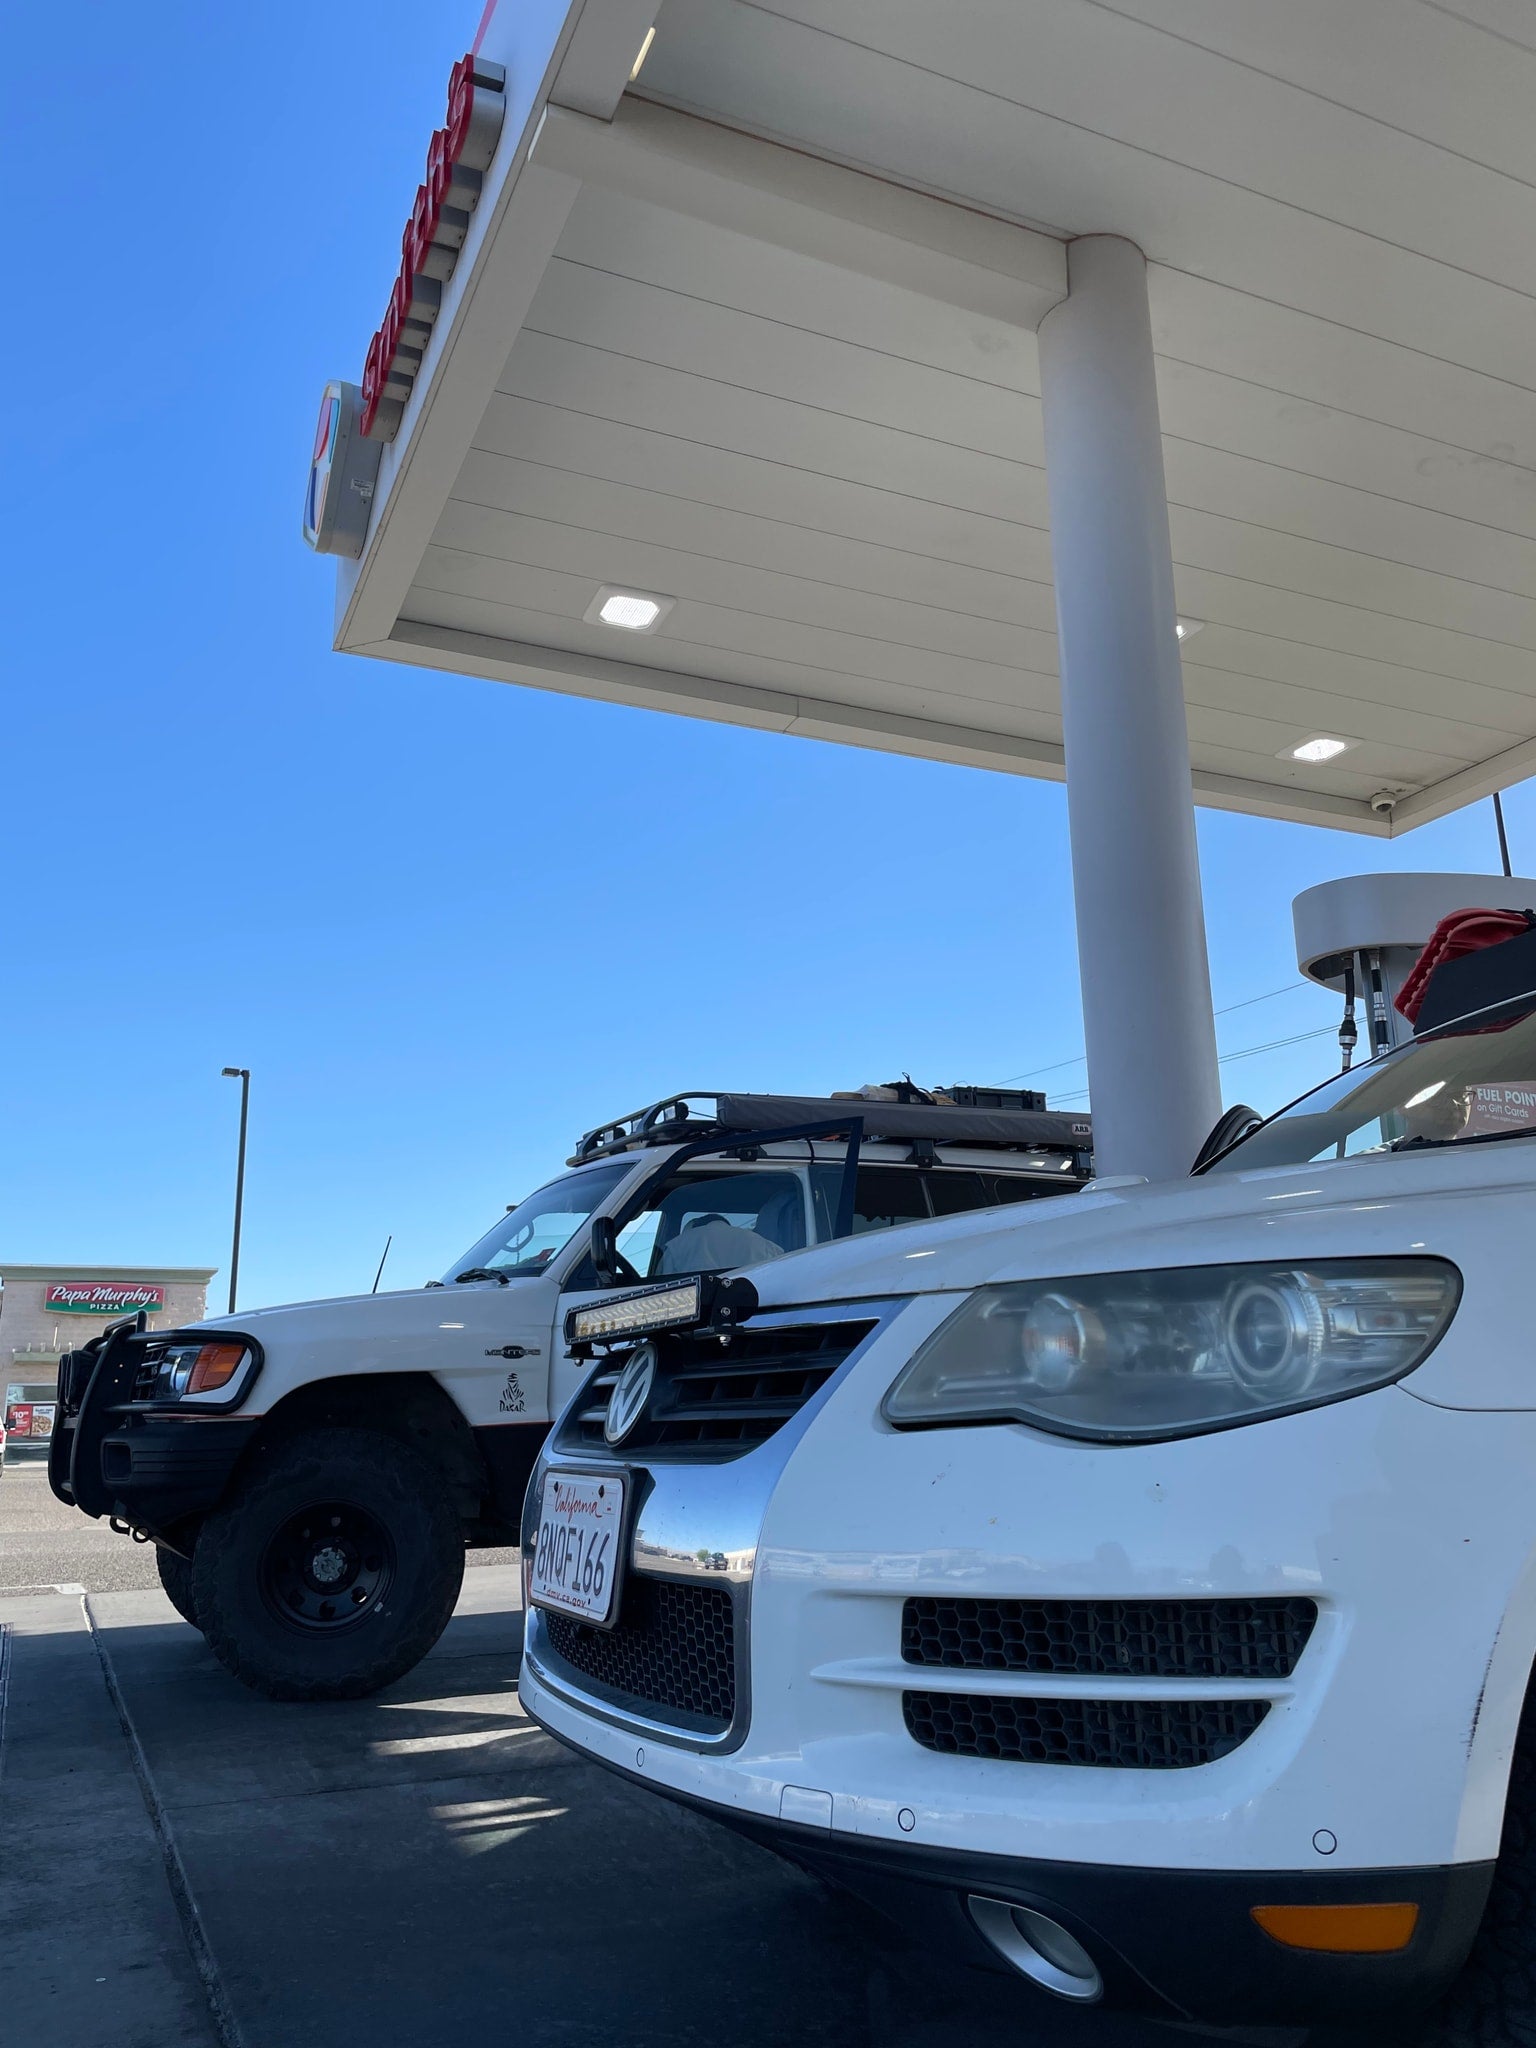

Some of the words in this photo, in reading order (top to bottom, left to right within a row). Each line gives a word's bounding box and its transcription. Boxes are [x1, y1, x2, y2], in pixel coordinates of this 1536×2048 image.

[1477, 1088, 1502, 1102] FUEL
[1477, 1104, 1487, 1112] on
[1489, 1103, 1503, 1114] Gift
[1504, 1105, 1529, 1118] Cards
[51, 1286, 91, 1306] Papa
[92, 1287, 159, 1307] Murphy's
[499, 1400, 527, 1413] DAKAR
[553, 1485, 603, 1523] California
[537, 1522, 610, 1597] 8NQF166
[546, 1588, 587, 1609] dmv.ca.gov
